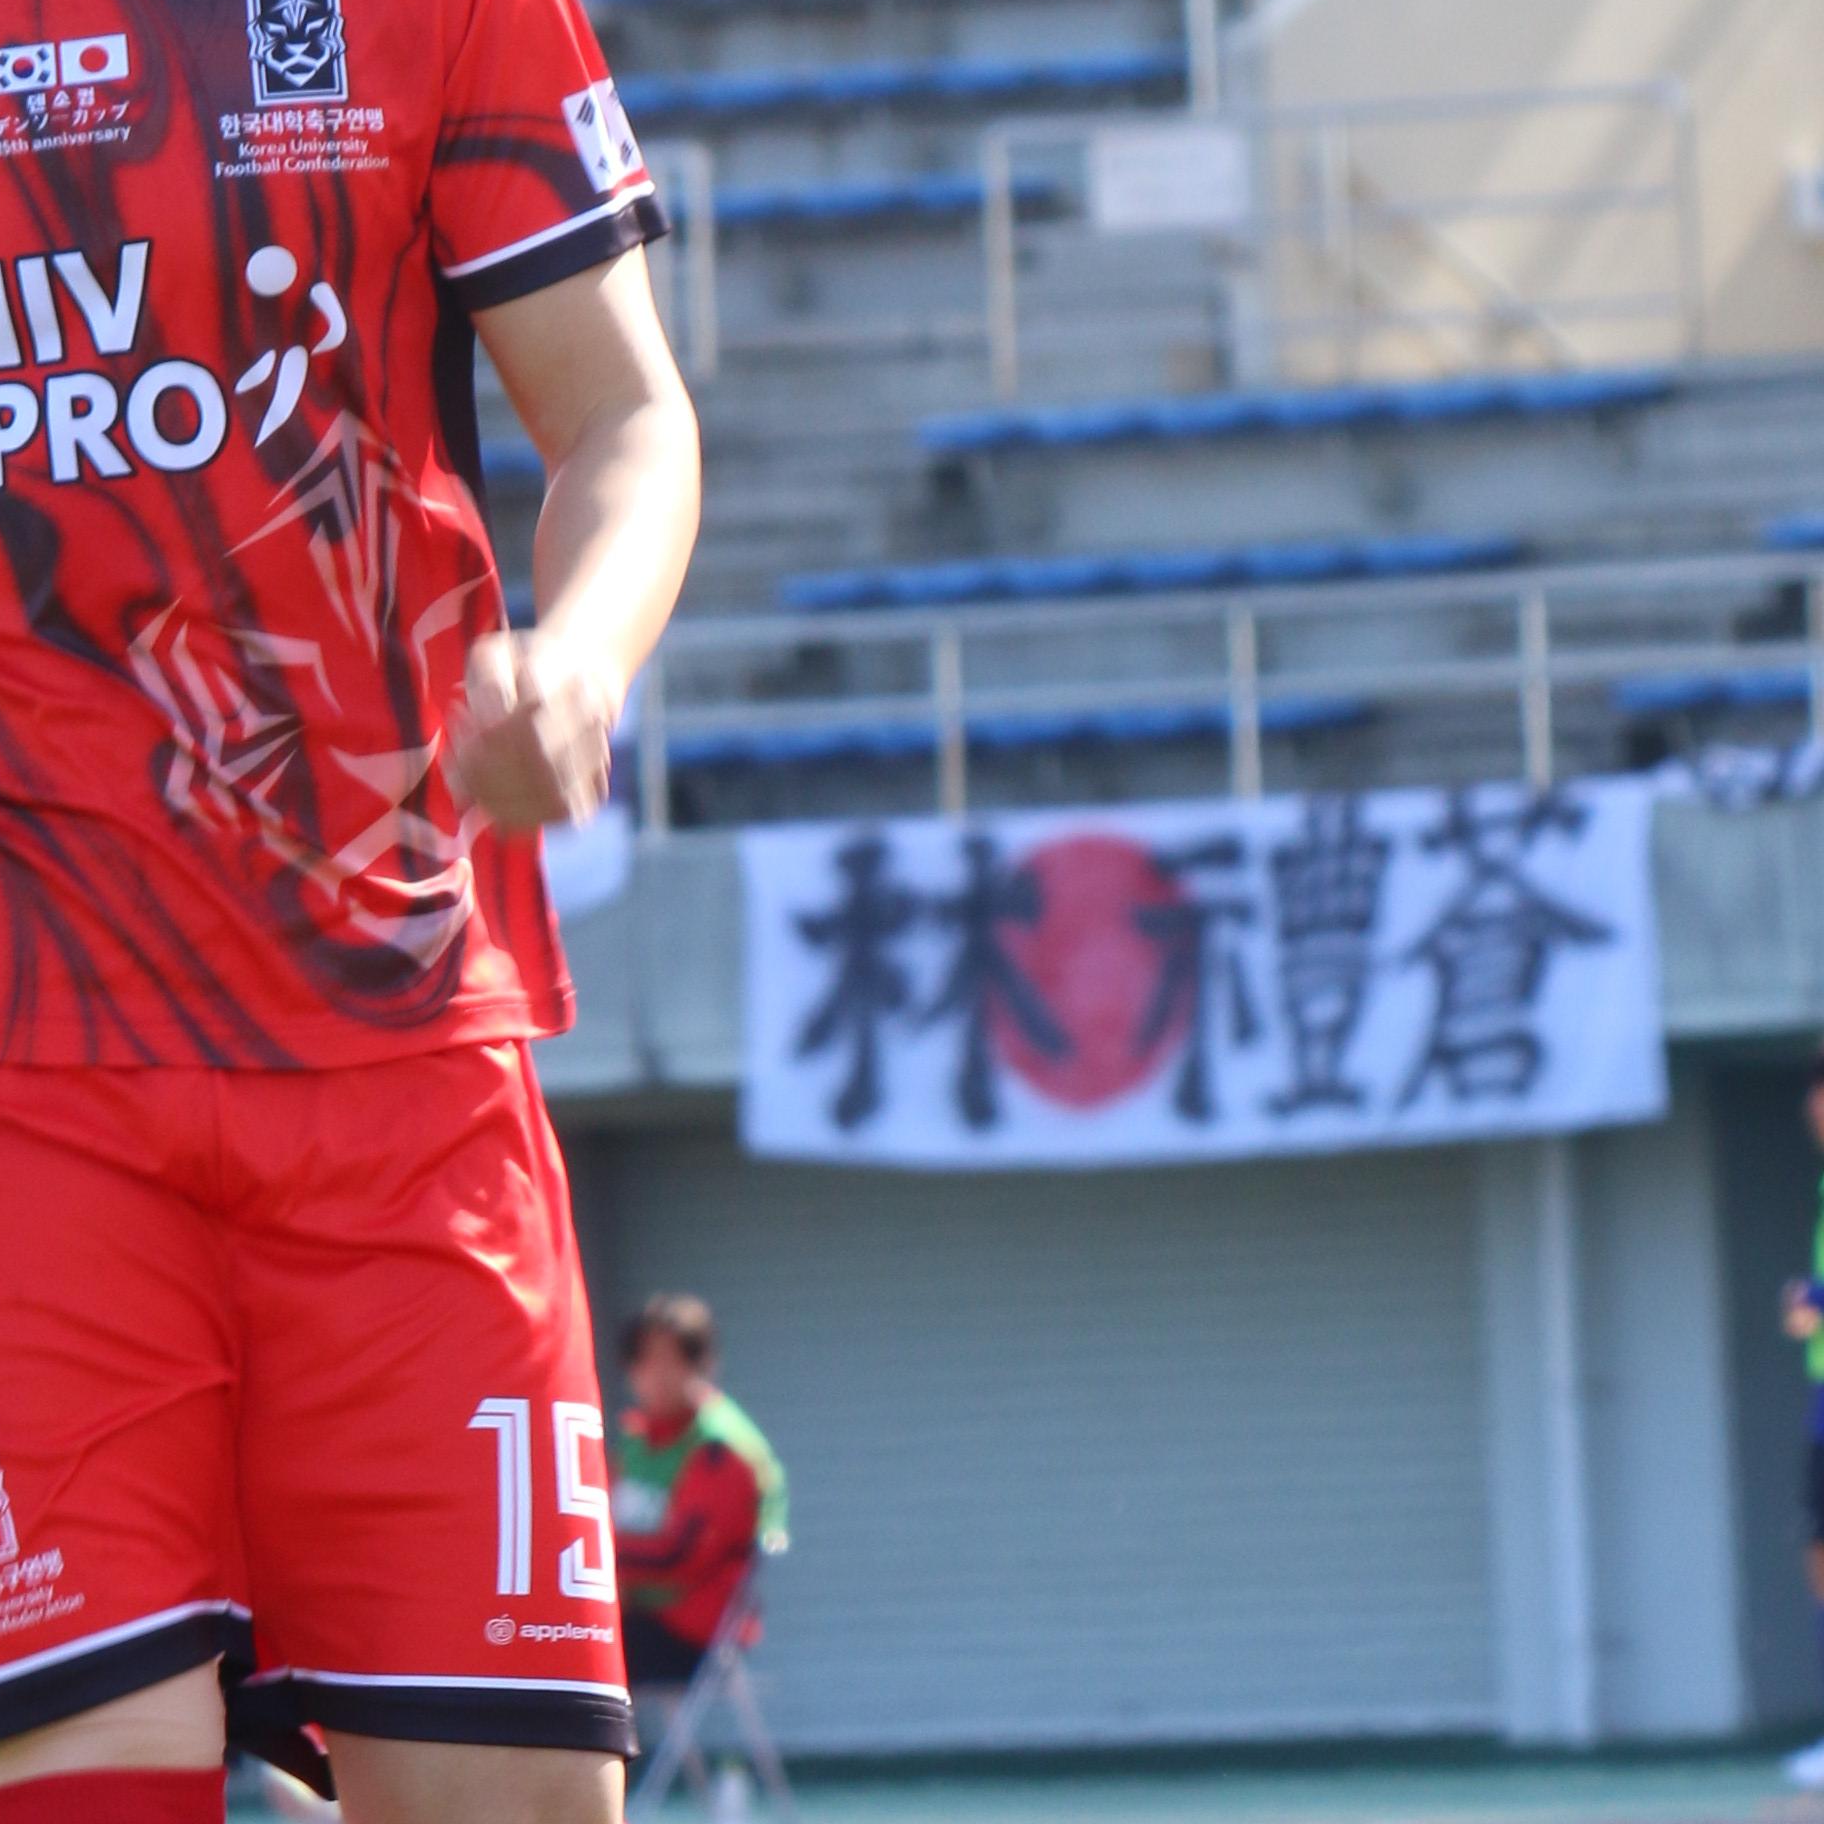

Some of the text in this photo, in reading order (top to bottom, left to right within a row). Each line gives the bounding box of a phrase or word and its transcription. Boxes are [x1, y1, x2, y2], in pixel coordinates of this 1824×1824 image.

[219, 107, 385, 139] 한국대학축구연맹
[32, 125, 132, 152] anniversary
[238, 136, 369, 159] Korea University
[215, 154, 390, 178] Football Confederation
[466, 1397, 616, 1604] 15
